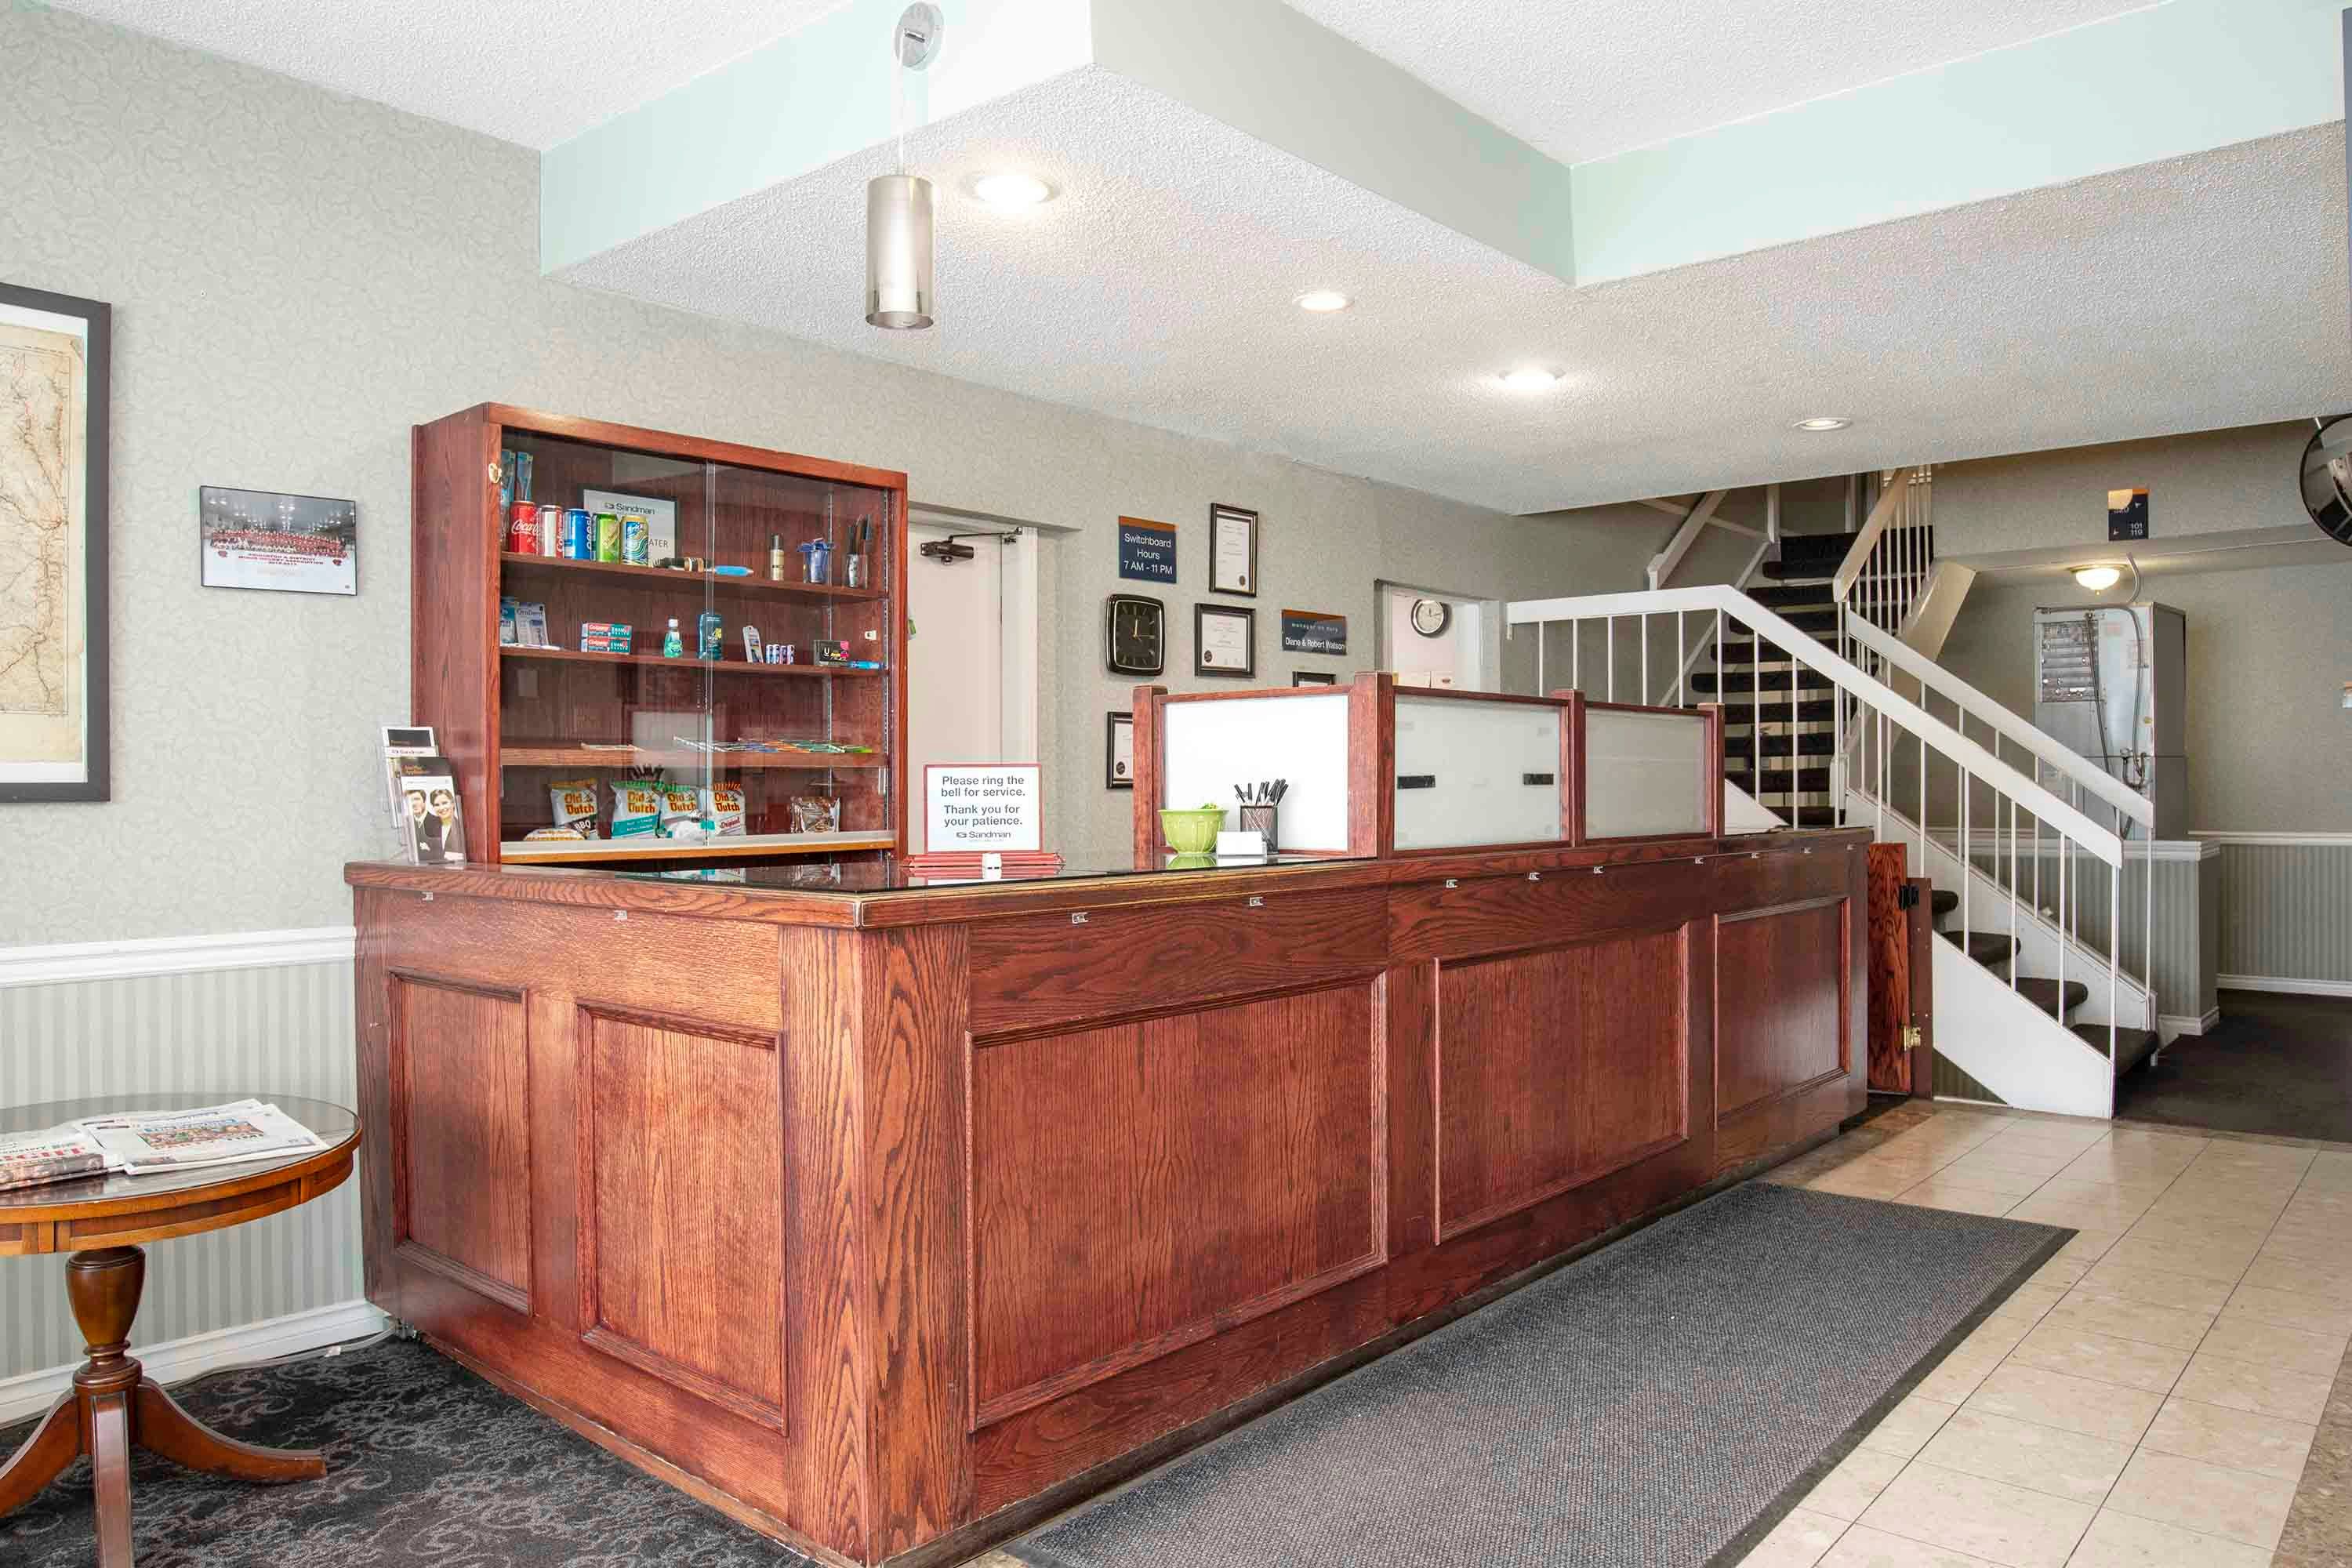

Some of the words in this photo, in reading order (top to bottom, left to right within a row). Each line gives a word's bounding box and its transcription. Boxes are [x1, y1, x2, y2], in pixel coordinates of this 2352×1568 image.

[616, 502, 655, 514] Sandman
[648, 539, 669, 548] ATER
[1124, 533, 1171, 547] Switchboard
[1137, 549, 1160, 560] Hours
[1123, 561, 1129, 570] 7
[1131, 561, 1144, 572] AM
[1151, 564, 1158, 573] 11
[1160, 564, 1173, 575] PM
[1285, 637, 1301, 647] Diane
[1301, 639, 1306, 648] &
[1307, 639, 1325, 648] Robert
[942, 776, 979, 785] Please
[982, 775, 1004, 786] ring
[1007, 775, 1025, 785] the
[627, 791, 644, 803] Old
[667, 793, 684, 802] Old
[714, 792, 729, 802] Old
[941, 788, 960, 797] bell
[964, 787, 980, 797] for
[983, 787, 1025, 797] service.
[564, 793, 583, 803] Old
[565, 804, 594, 815] Dutch
[627, 803, 656, 814] Dutch
[669, 802, 696, 811] Dutch
[715, 802, 740, 812] Dutch
[944, 804, 978, 814] Thank
[981, 806, 1001, 815] you
[1004, 804, 1021, 813] for
[574, 820, 591, 830] BBQ
[944, 818, 969, 827] your
[972, 816, 1022, 827] patience.
